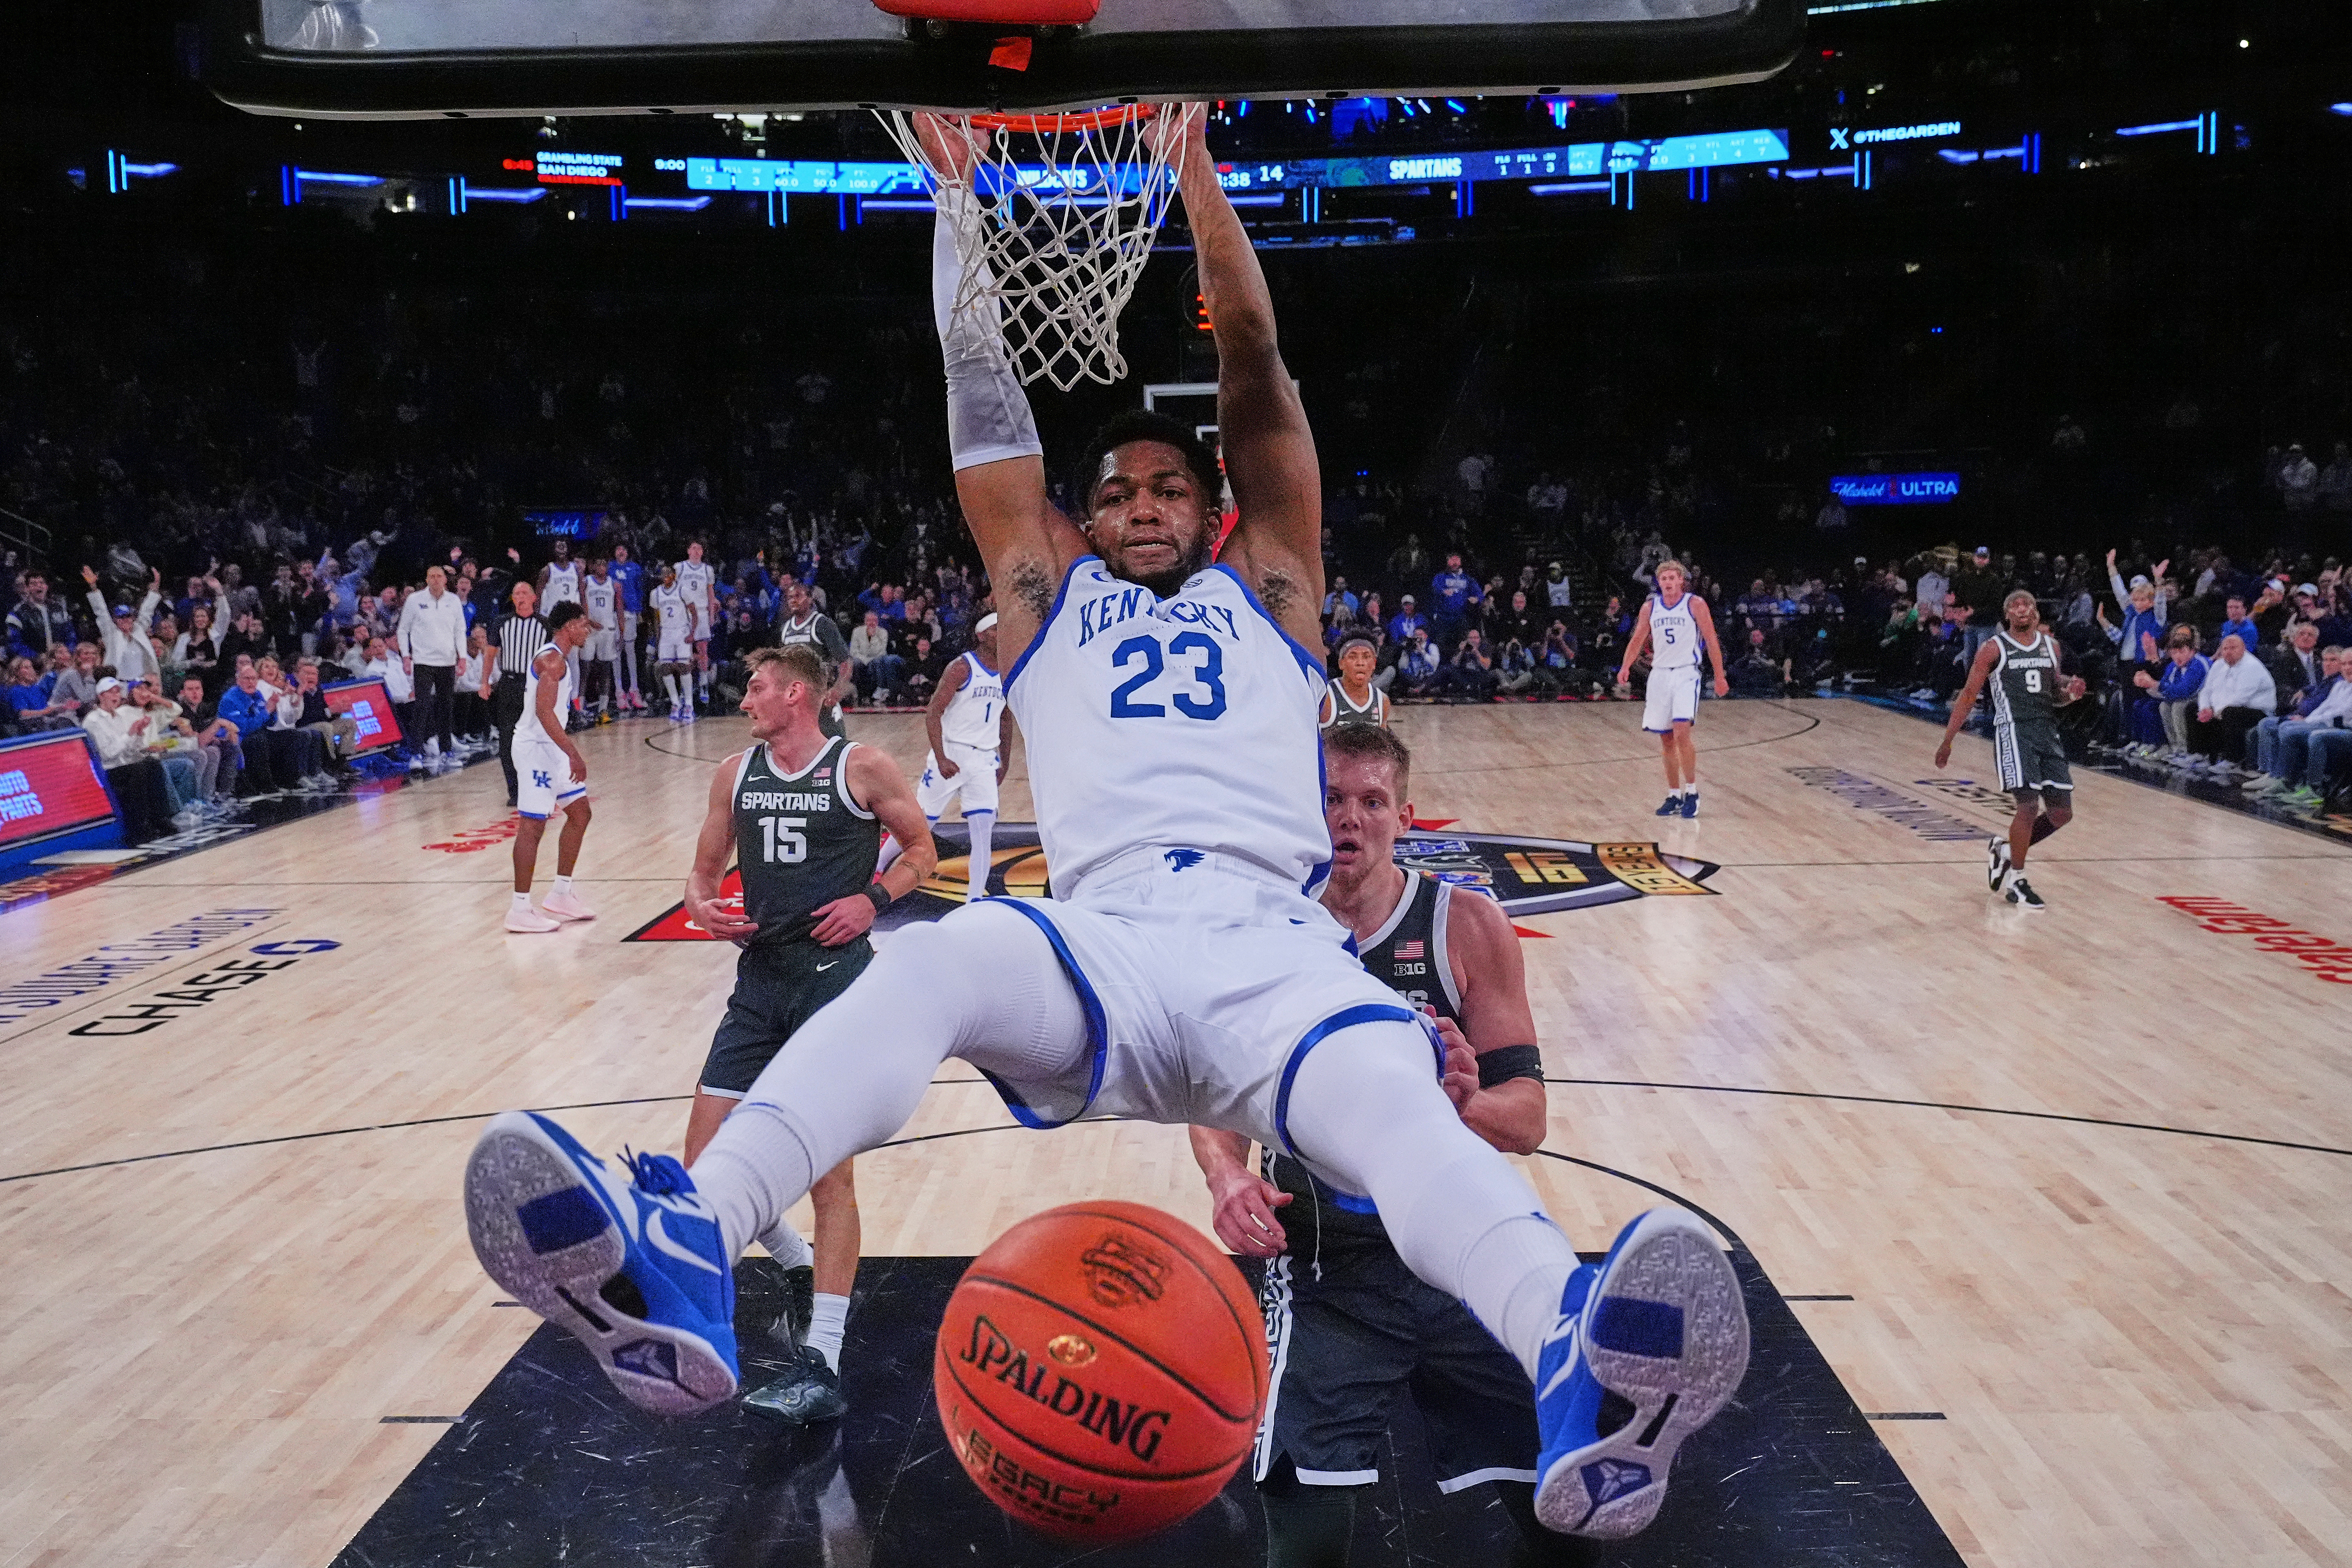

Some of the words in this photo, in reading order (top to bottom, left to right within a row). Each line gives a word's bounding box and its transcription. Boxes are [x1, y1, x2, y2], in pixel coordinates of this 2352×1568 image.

[1853, 121, 1961, 144] @THEGARDEN
[536, 151, 593, 165] GRAMBLING
[593, 155, 623, 167] STATE
[1713, 151, 1718, 160] 1
[1734, 149, 1742, 157] 4
[1758, 146, 1766, 156] 7
[537, 163, 566, 175] SAN
[566, 165, 607, 177] DIEGO
[654, 159, 686, 171] 9:00
[1259, 165, 1284, 182] 14
[1389, 157, 1462, 180] SPARTANS
[1500, 165, 1507, 175] 1
[1524, 163, 1531, 174] 1
[705, 175, 713, 184] 2
[731, 175, 736, 185] 1
[849, 180, 879, 189] 100.0
[1901, 480, 1958, 496] ULTRA
[1664, 628, 1675, 644] 5
[1110, 631, 1227, 721] 23
[2025, 669, 2042, 693] 9
[985, 701, 992, 723] 1
[742, 792, 830, 812] SPARTANS
[758, 816, 807, 863] 15
[68, 959, 300, 1036] CHASE
[960, 1315, 1171, 1462] SPALDING
